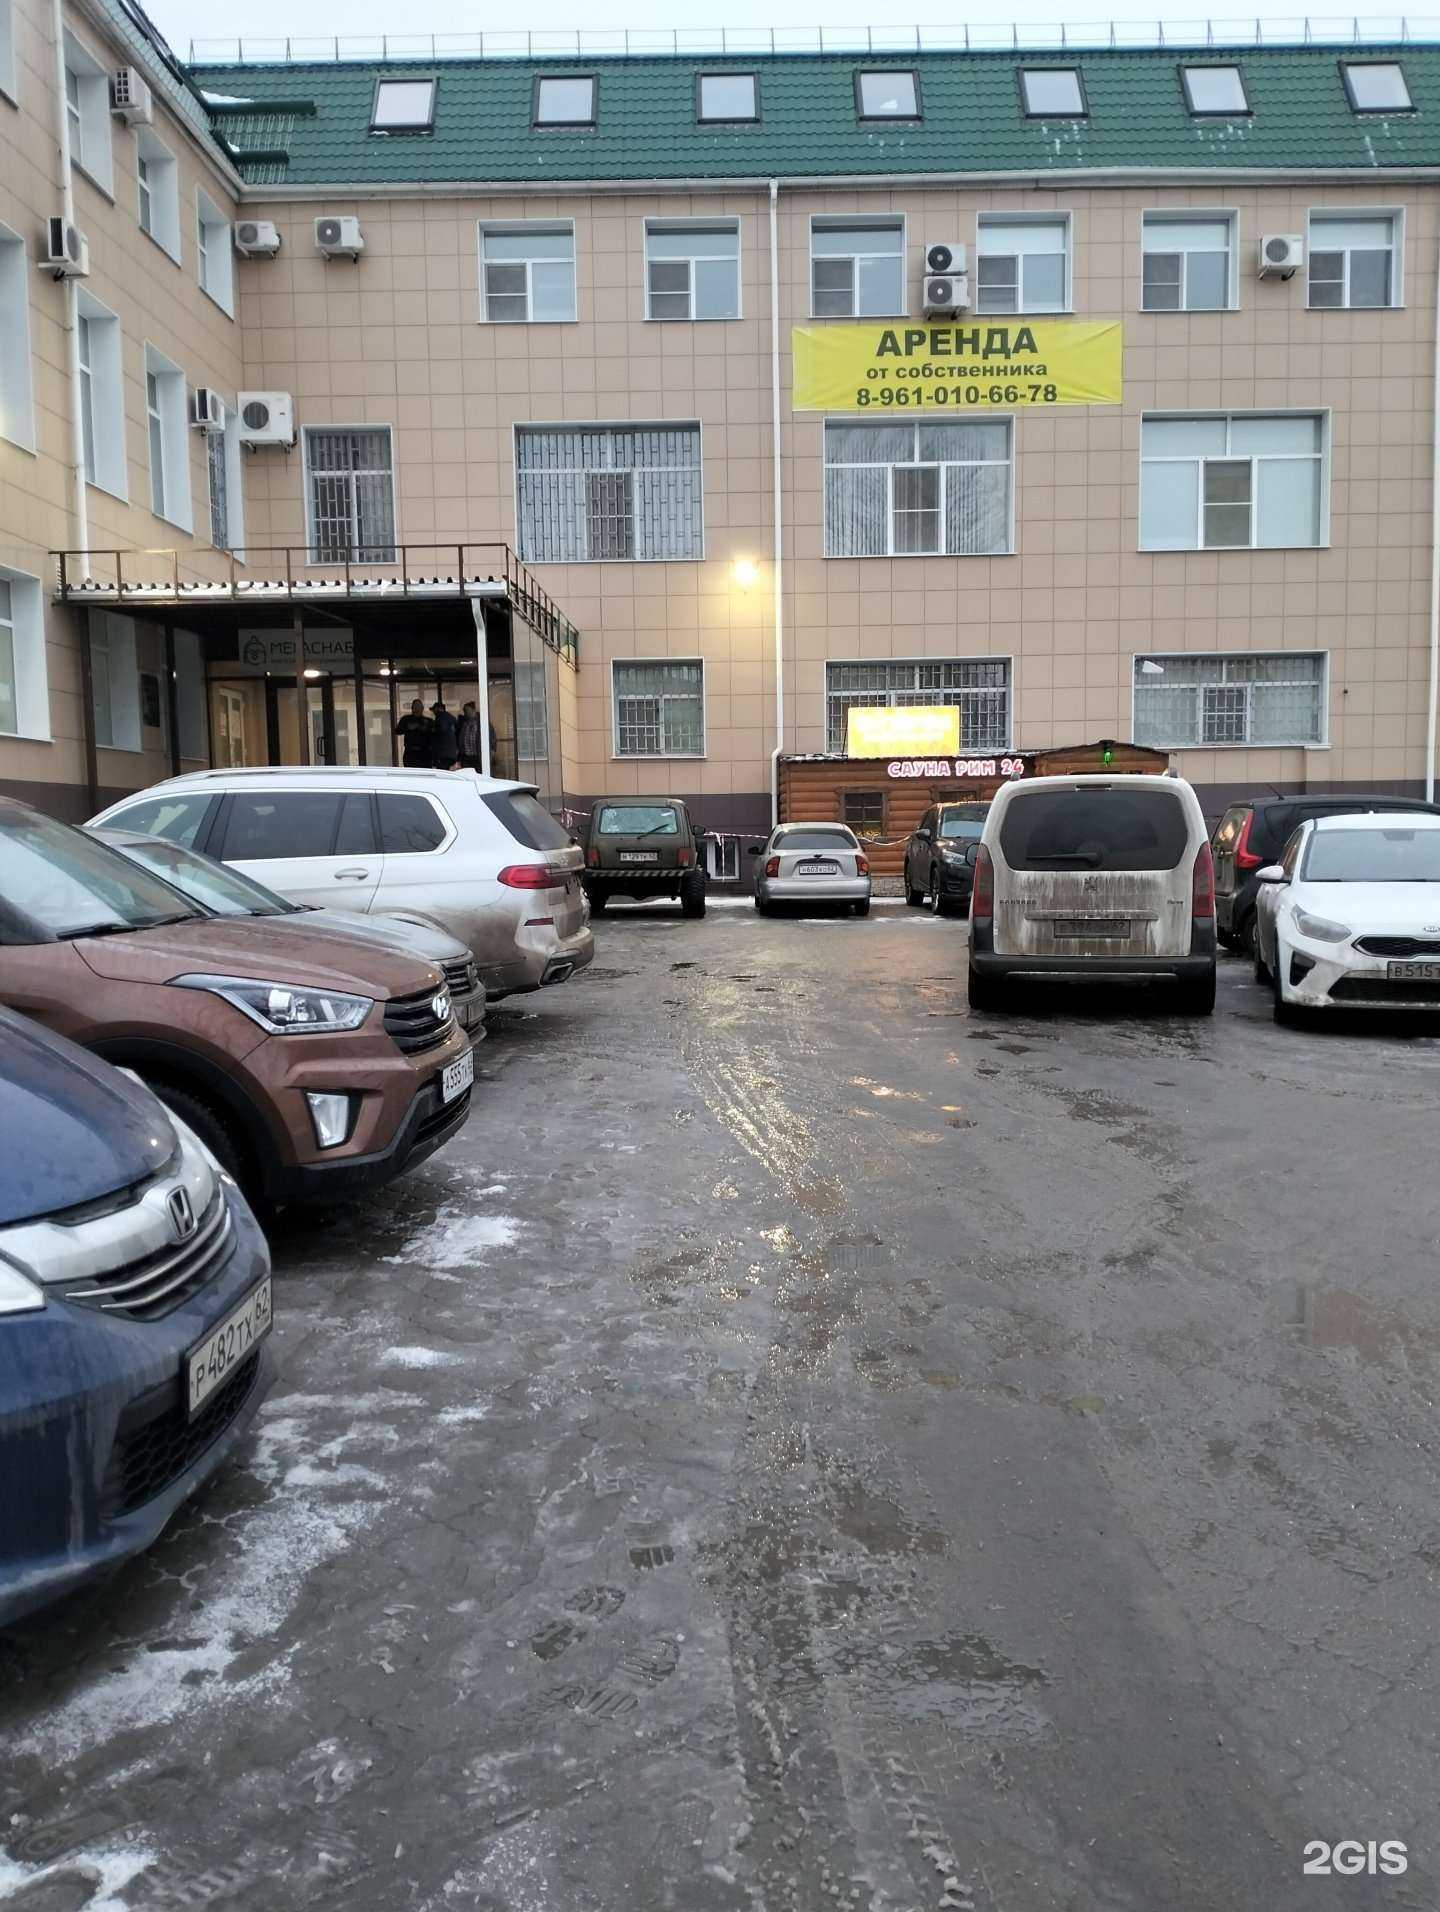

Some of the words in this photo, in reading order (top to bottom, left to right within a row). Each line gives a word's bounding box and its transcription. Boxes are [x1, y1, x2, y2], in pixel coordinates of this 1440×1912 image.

[876, 327, 1038, 360] АРЕНДА
[866, 367, 888, 379] от
[895, 363, 1047, 379] собственника
[856, 383, 1058, 406] 8-961-010-66-78
[888, 761, 950, 777] САУНА
[956, 760, 996, 776] РИМ
[1001, 759, 1024, 775] 24
